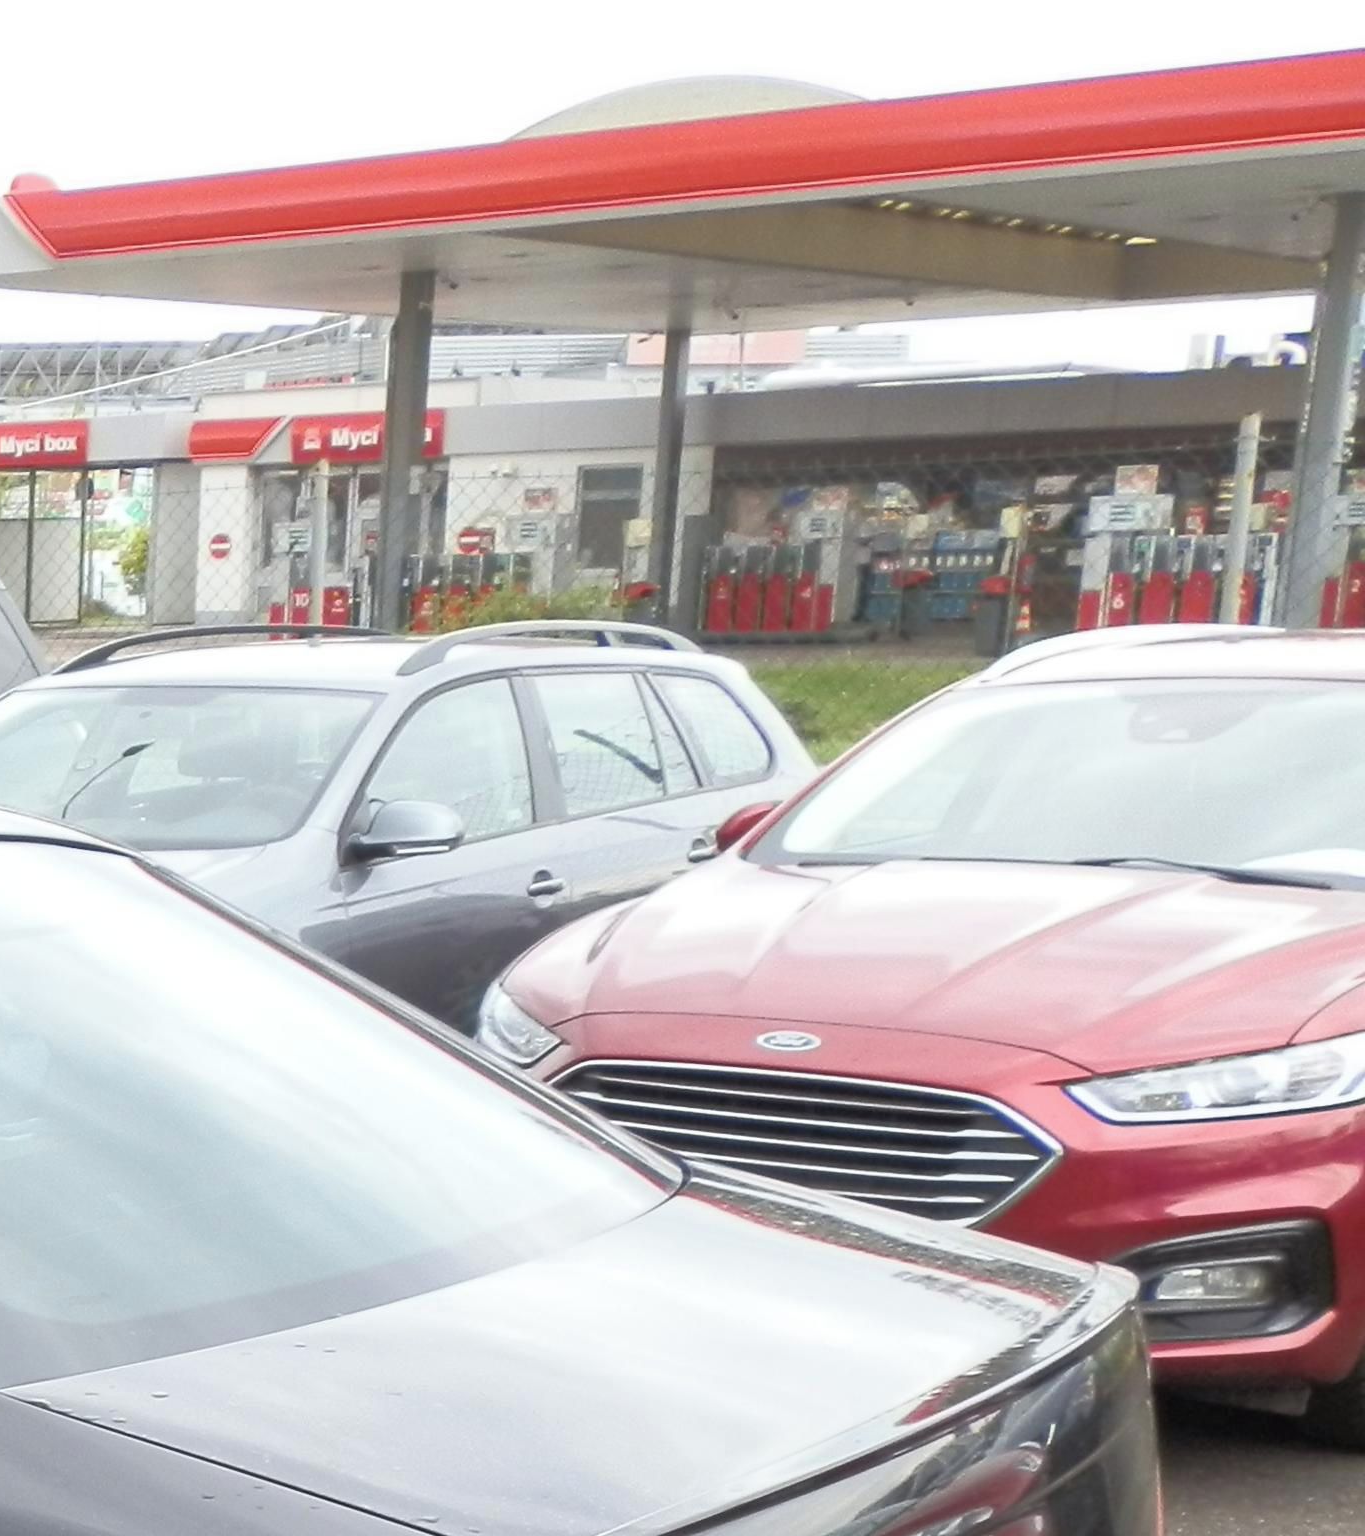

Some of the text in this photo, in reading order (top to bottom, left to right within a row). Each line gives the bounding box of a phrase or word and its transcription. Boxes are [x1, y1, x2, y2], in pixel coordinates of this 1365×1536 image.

[0, 432, 77, 458] Mycí box
[292, 591, 310, 607] 10
